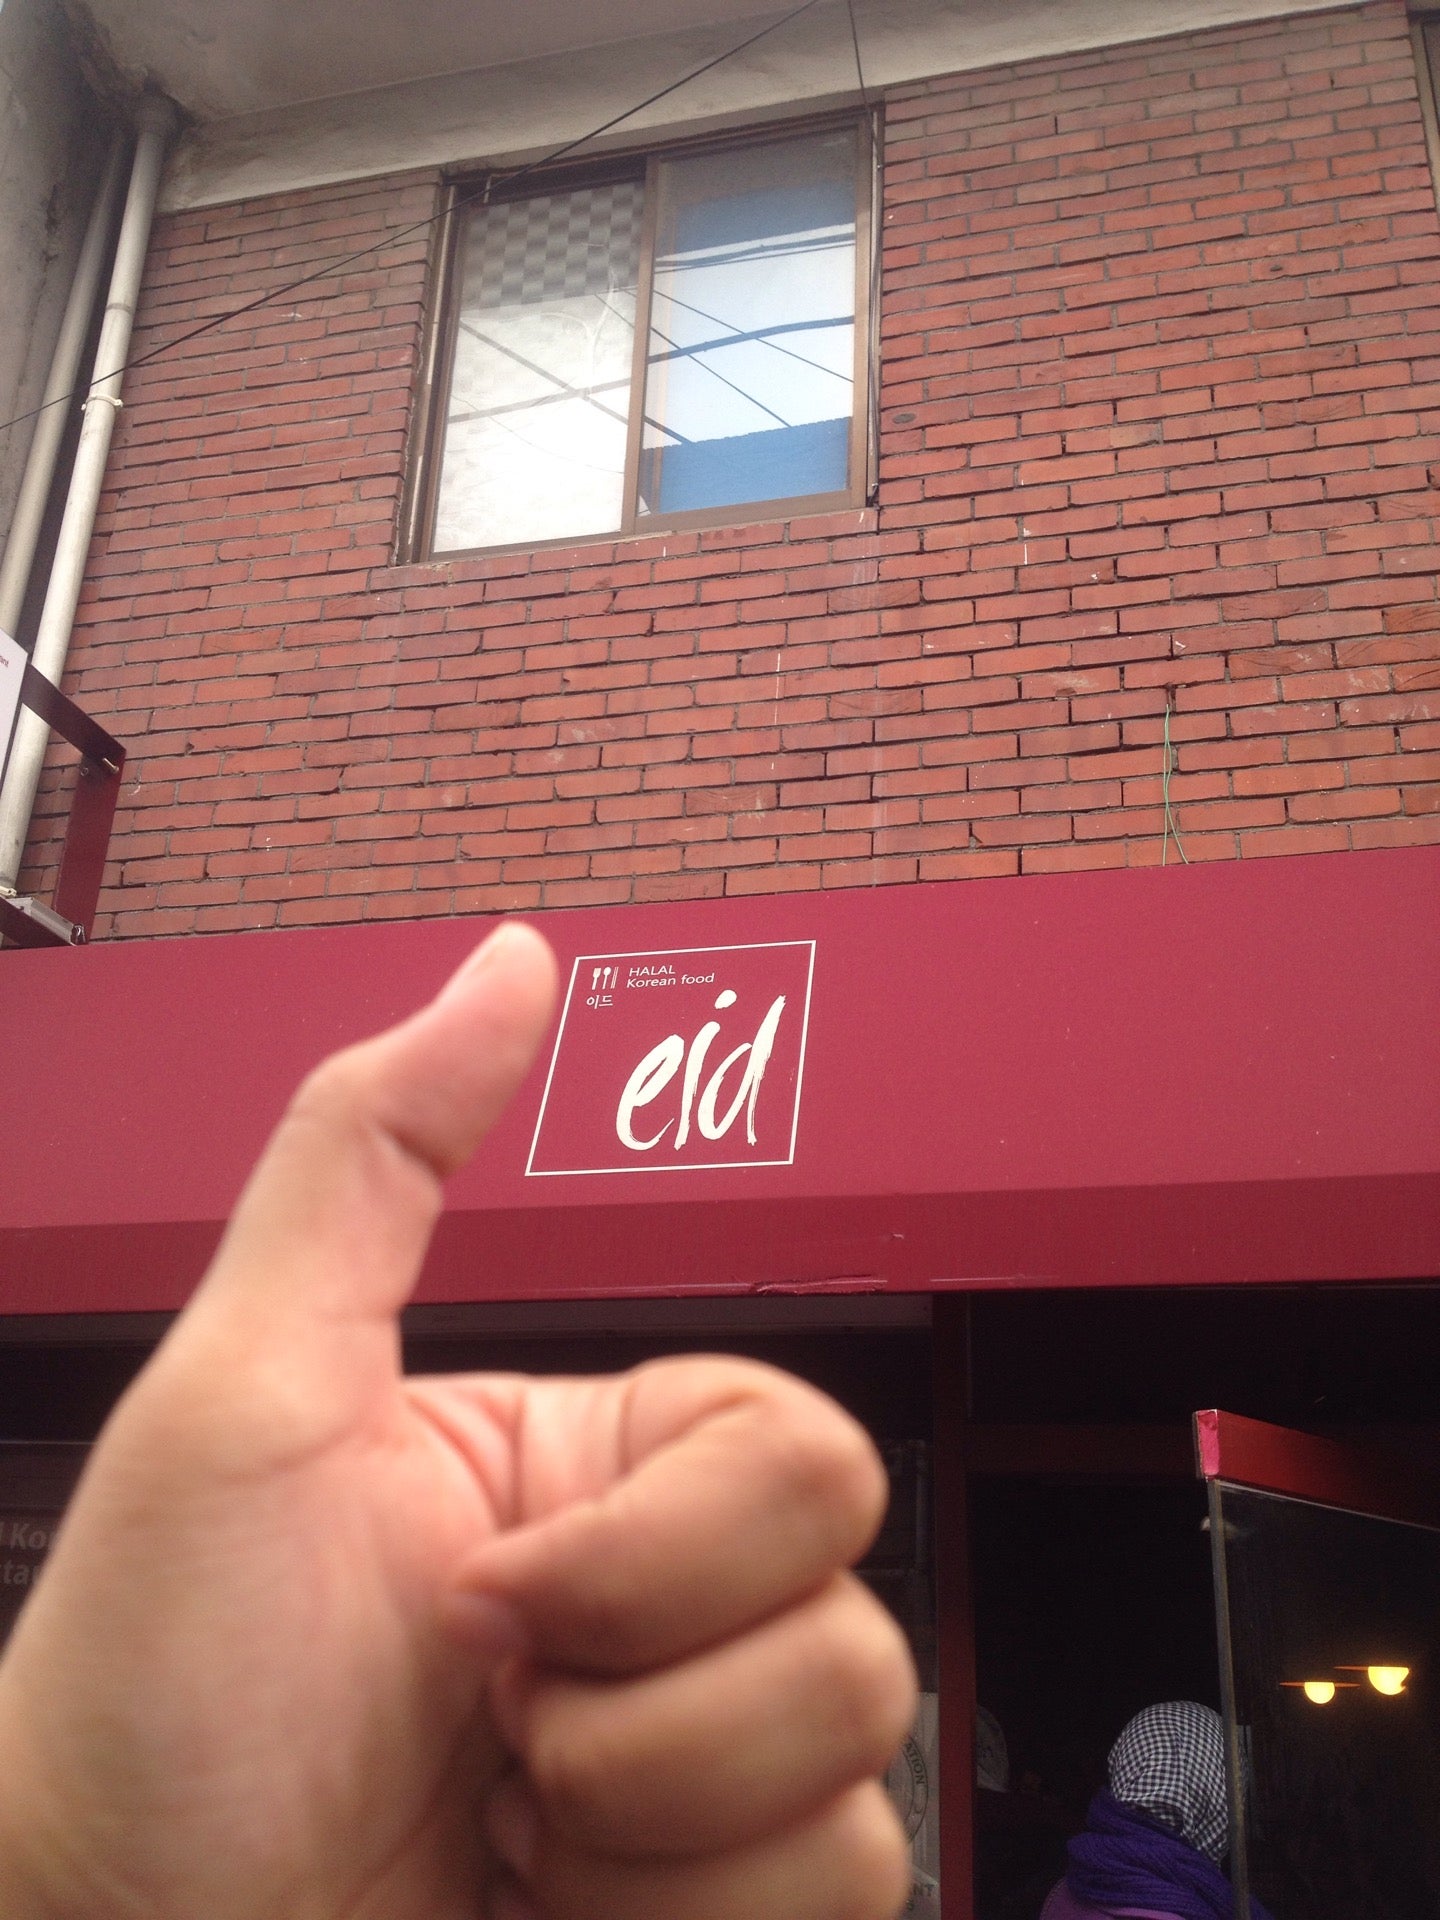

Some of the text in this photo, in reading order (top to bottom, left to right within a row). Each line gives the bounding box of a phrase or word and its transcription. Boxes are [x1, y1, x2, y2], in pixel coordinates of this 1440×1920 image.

[629, 965, 676, 977] HALAL
[626, 972, 715, 988] Korean food
[586, 994, 614, 1010] 이드
[615, 989, 786, 1151] eid
